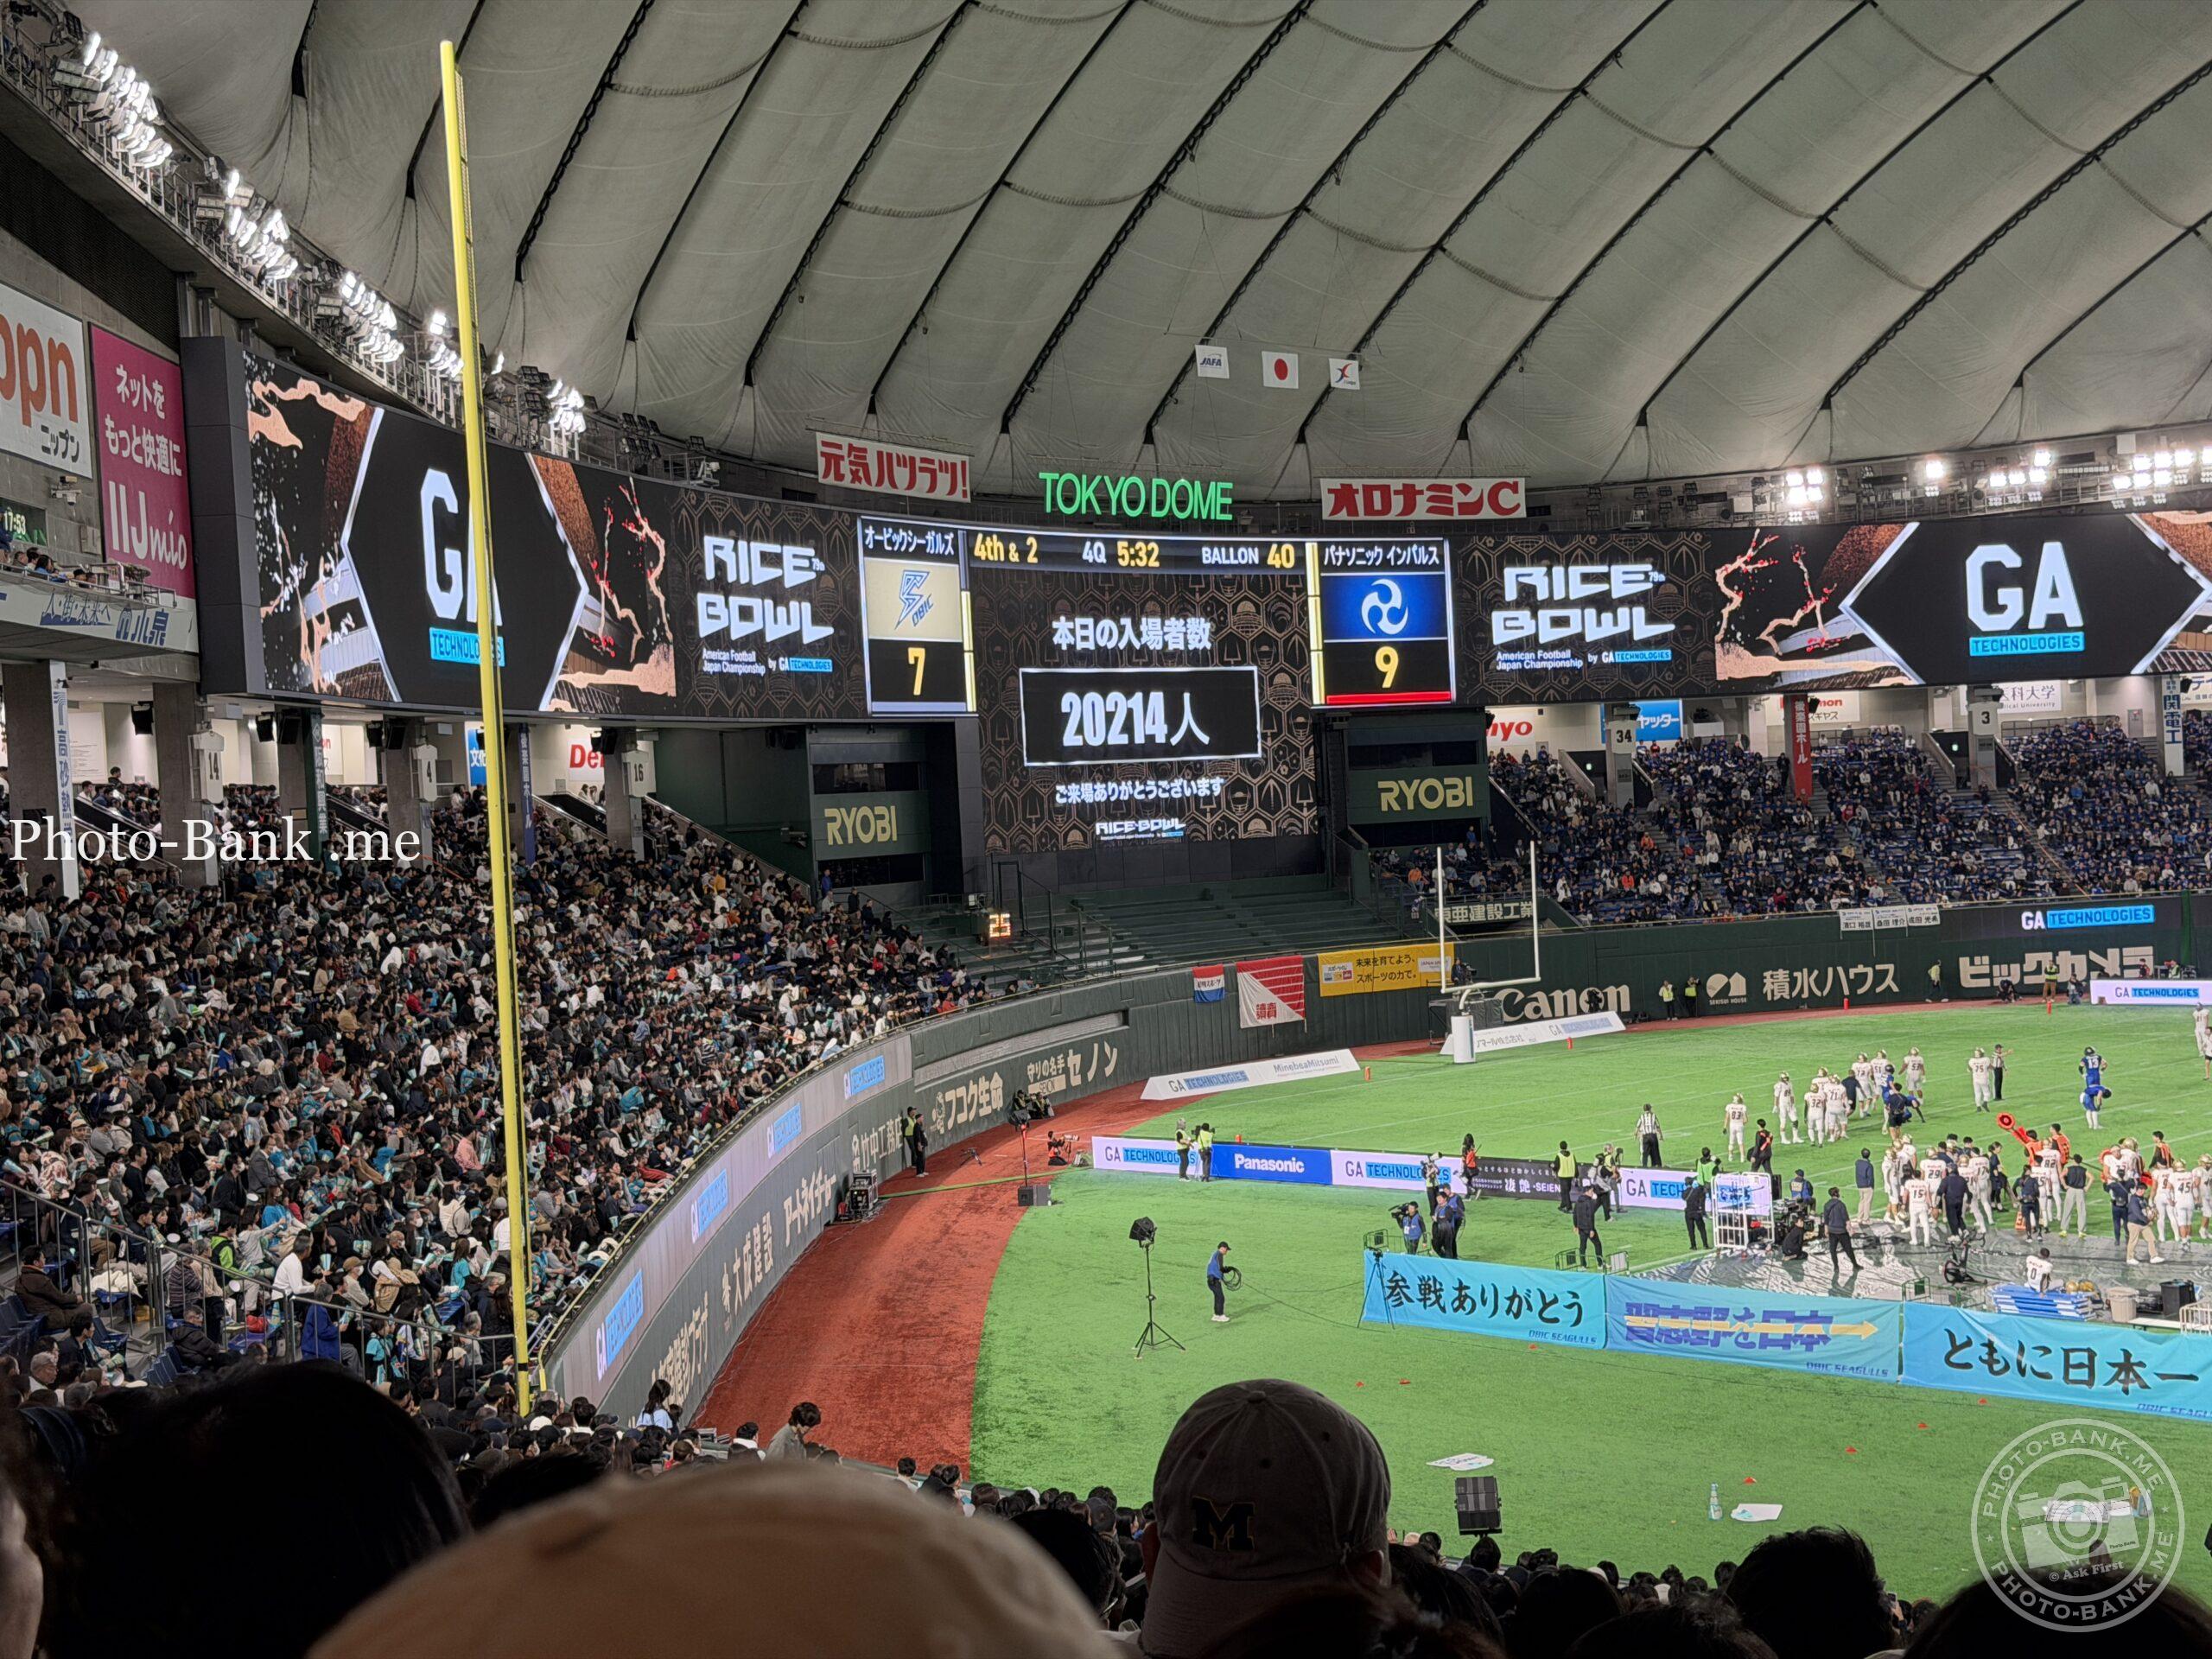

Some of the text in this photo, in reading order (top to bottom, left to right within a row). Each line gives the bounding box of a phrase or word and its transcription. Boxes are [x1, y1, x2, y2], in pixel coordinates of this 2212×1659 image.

[1199, 356, 1223, 367] JAFA
[116, 364, 165, 419] ネットを
[41, 424, 79, 463] ニップン
[105, 414, 181, 476] もっと快適に
[1039, 473, 1234, 520] TOKYO DOME
[1327, 480, 1522, 518] オロナミンC
[109, 480, 187, 570] IIJmio
[704, 536, 817, 588] RICE
[974, 532, 1039, 563] 4th & 2
[1082, 541, 1107, 563] 4Q
[1116, 540, 1160, 568] 5:32
[1202, 543, 1295, 569] BALLON 40
[1324, 543, 1440, 566] パナソニック インパルス
[1503, 564, 1653, 602] RICE
[1965, 541, 2084, 632] GA
[697, 592, 835, 645] BOWL
[911, 594, 934, 627] OBIC
[1052, 616, 1211, 651] 本日の入場者数
[1491, 607, 1675, 645] BOWL
[432, 632, 504, 663] TECHNOLOS
[702, 648, 757, 663] American Football
[1497, 649, 1571, 661] American Football
[1587, 651, 1670, 664] by GA TECHNOLOGIES
[1973, 635, 2082, 652] TECHNOLOGIES
[702, 661, 766, 677] Japan Championship
[768, 657, 831, 671] by GA TECHNOLOGIES
[908, 647, 925, 696] 7
[1375, 646, 1399, 689] 9
[1496, 658, 1583, 671] Japan Championship
[1061, 690, 1211, 747] 20214人
[1981, 711, 1990, 724] 3
[1616, 729, 1632, 743] 34
[633, 763, 644, 782] 16
[1055, 777, 1224, 804] ご来場ありがとうございます
[1377, 776, 1473, 811] RYOBI
[824, 805, 898, 845] RYOBI
[1096, 817, 1186, 836] RICE BOWL
[1434, 901, 1535, 924] 東亜建設工業
[2021, 907, 2152, 931] GA TECHNOLOGIES
[1357, 970, 1417, 983] スポーツの力で。
[1959, 946, 2153, 988] ビックカメラ
[1763, 963, 1899, 1001] 積水ハウス
[2115, 987, 2200, 998] GA TECHNOLOGIES
[1491, 984, 1631, 1022] Canon
[1027, 1053, 1065, 1082] 守りの名手
[1067, 1040, 1118, 1087] セノン
[1274, 1055, 1339, 1074] MinebeaMitsumi
[1168, 1071, 1247, 1093] GA TECHNOLOGIES
[945, 1071, 1003, 1130] フコク生命
[1105, 1146, 1121, 1162] GA
[1235, 1153, 1305, 1173] Panasonic
[1345, 1160, 1363, 1178] GA
[1626, 1179, 1647, 1198] GA
[2178, 1182, 2191, 1193] 45
[784, 1166, 837, 1247] アートネイチャー
[733, 1211, 773, 1316] 大成建設
[1387, 1271, 1583, 1328] 参戦ありがとう
[1529, 1330, 1597, 1345] OBIC SEAGULLS
[1806, 1362, 1889, 1377] OBIC SEAGULLS
[1943, 1328, 2199, 1395] ともに日本一
[1192, 1496, 1255, 1552] M
